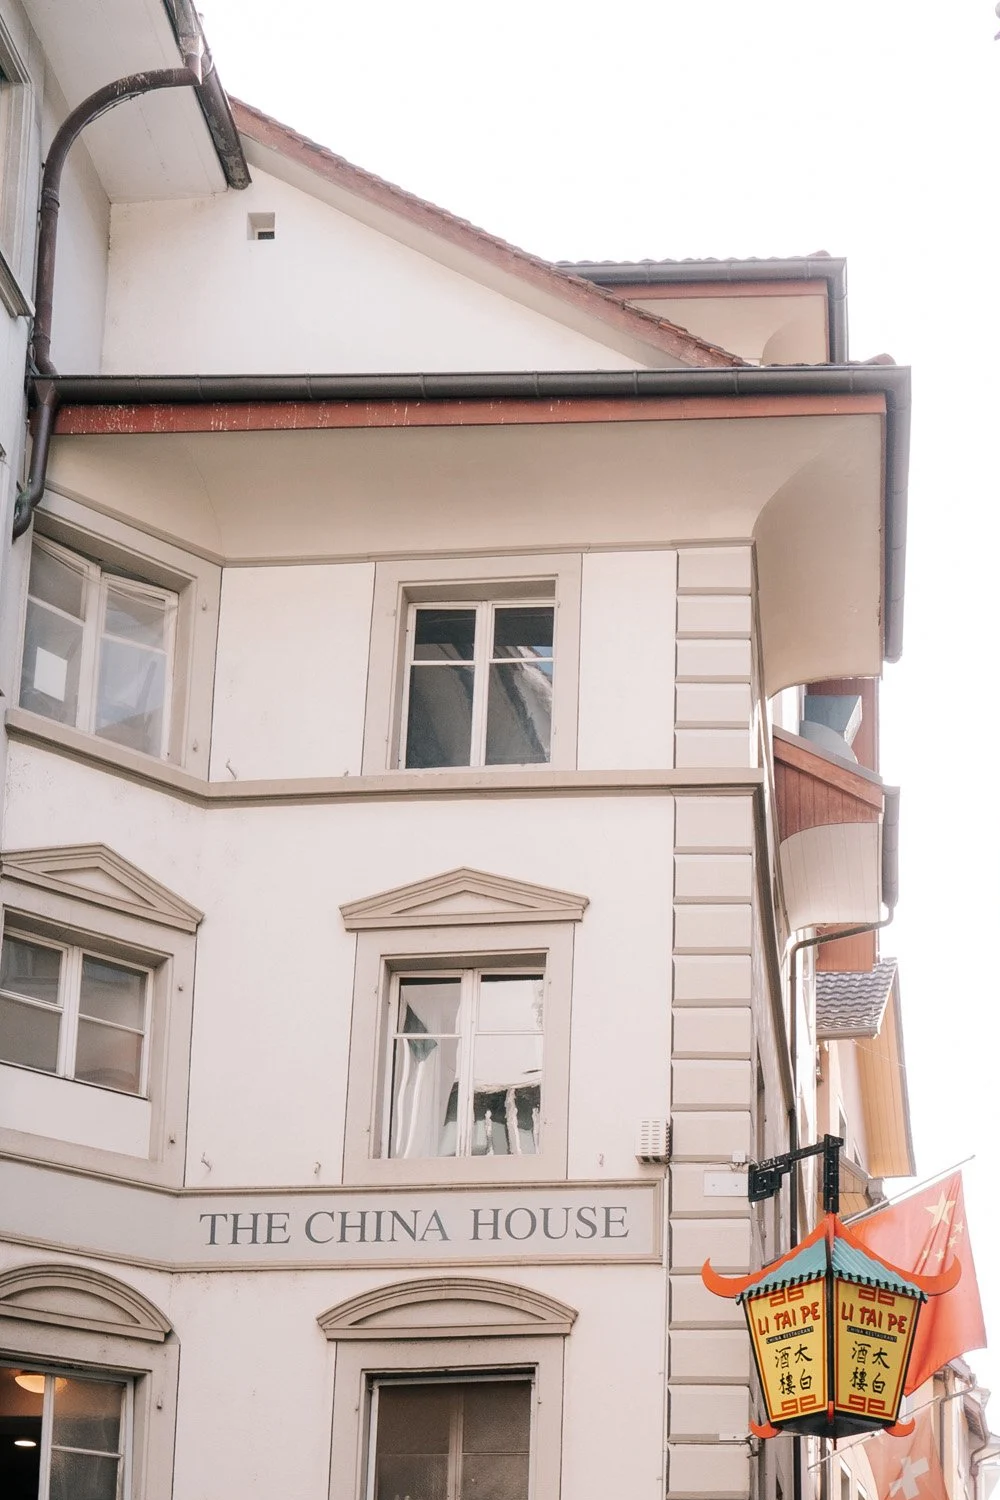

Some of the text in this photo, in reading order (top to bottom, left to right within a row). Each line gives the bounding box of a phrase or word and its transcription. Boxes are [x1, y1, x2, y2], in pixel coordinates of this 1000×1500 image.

[199, 1206, 630, 1246] THE CHINA HOUSE
[758, 1301, 821, 1336] LI TAI PE
[841, 1302, 908, 1334] LI TAI PE
[847, 1325, 898, 1343] CHINA RESTAURANT
[766, 1326, 814, 1345] CHINA RESTAURANT
